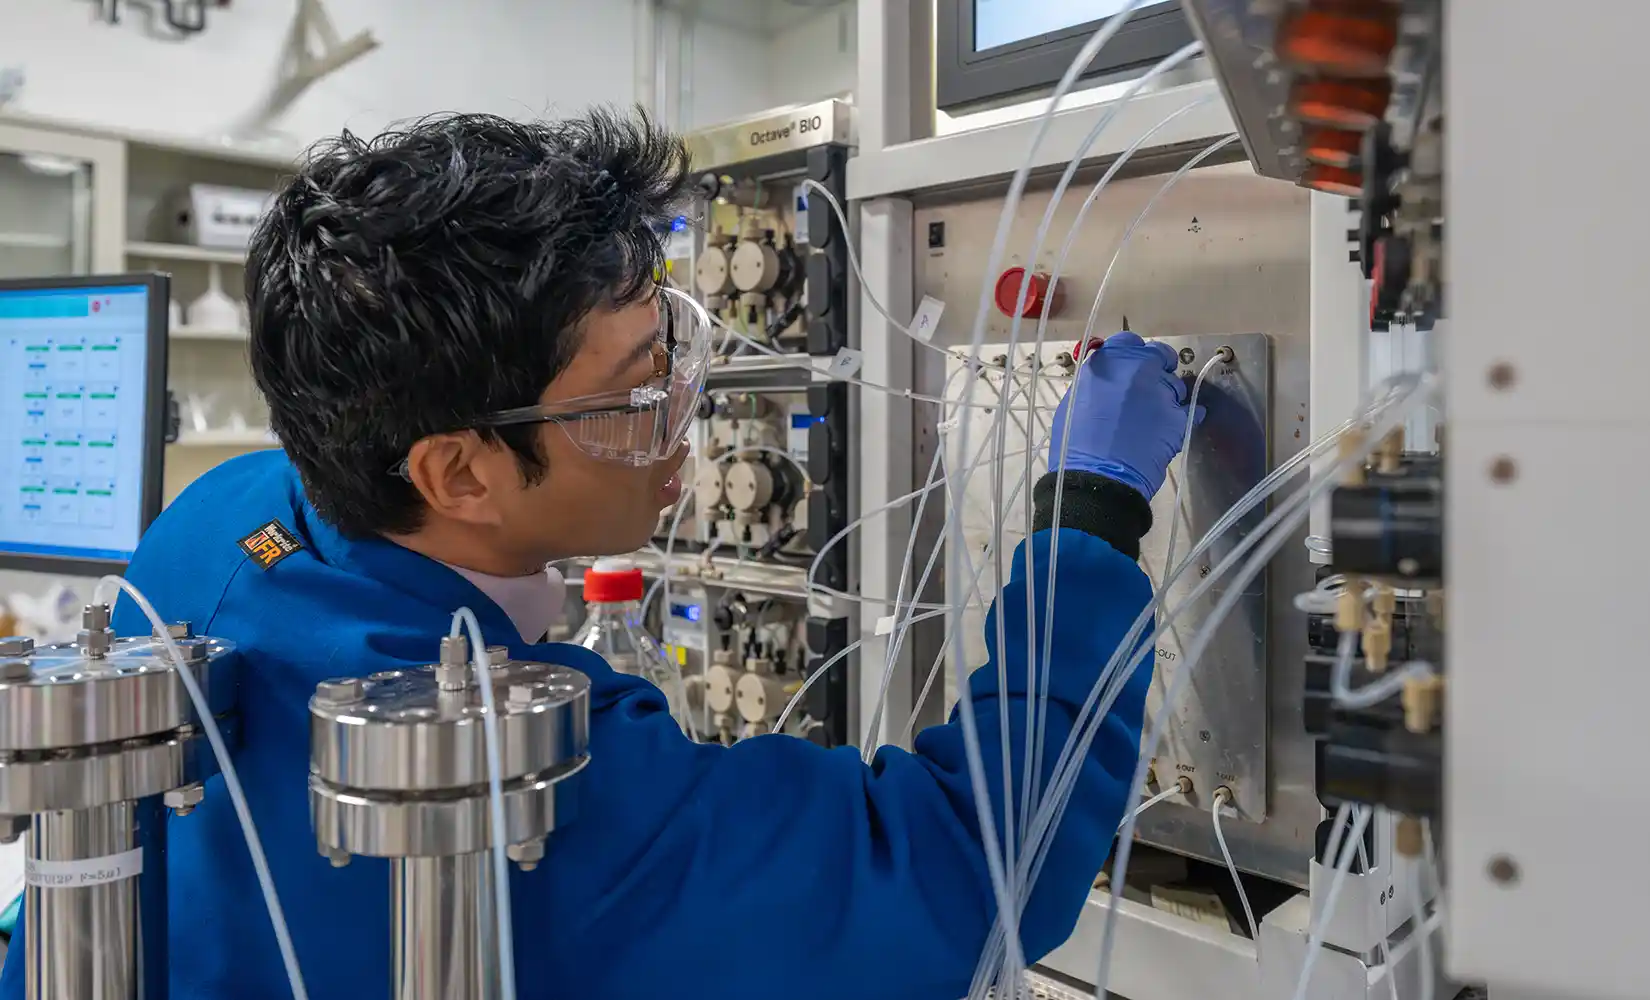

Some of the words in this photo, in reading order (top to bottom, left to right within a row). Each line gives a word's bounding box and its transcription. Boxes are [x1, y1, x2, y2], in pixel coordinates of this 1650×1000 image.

[800, 116, 821, 133] BIO
[252, 539, 281, 564] FR
[1181, 764, 1195, 773] OUT
